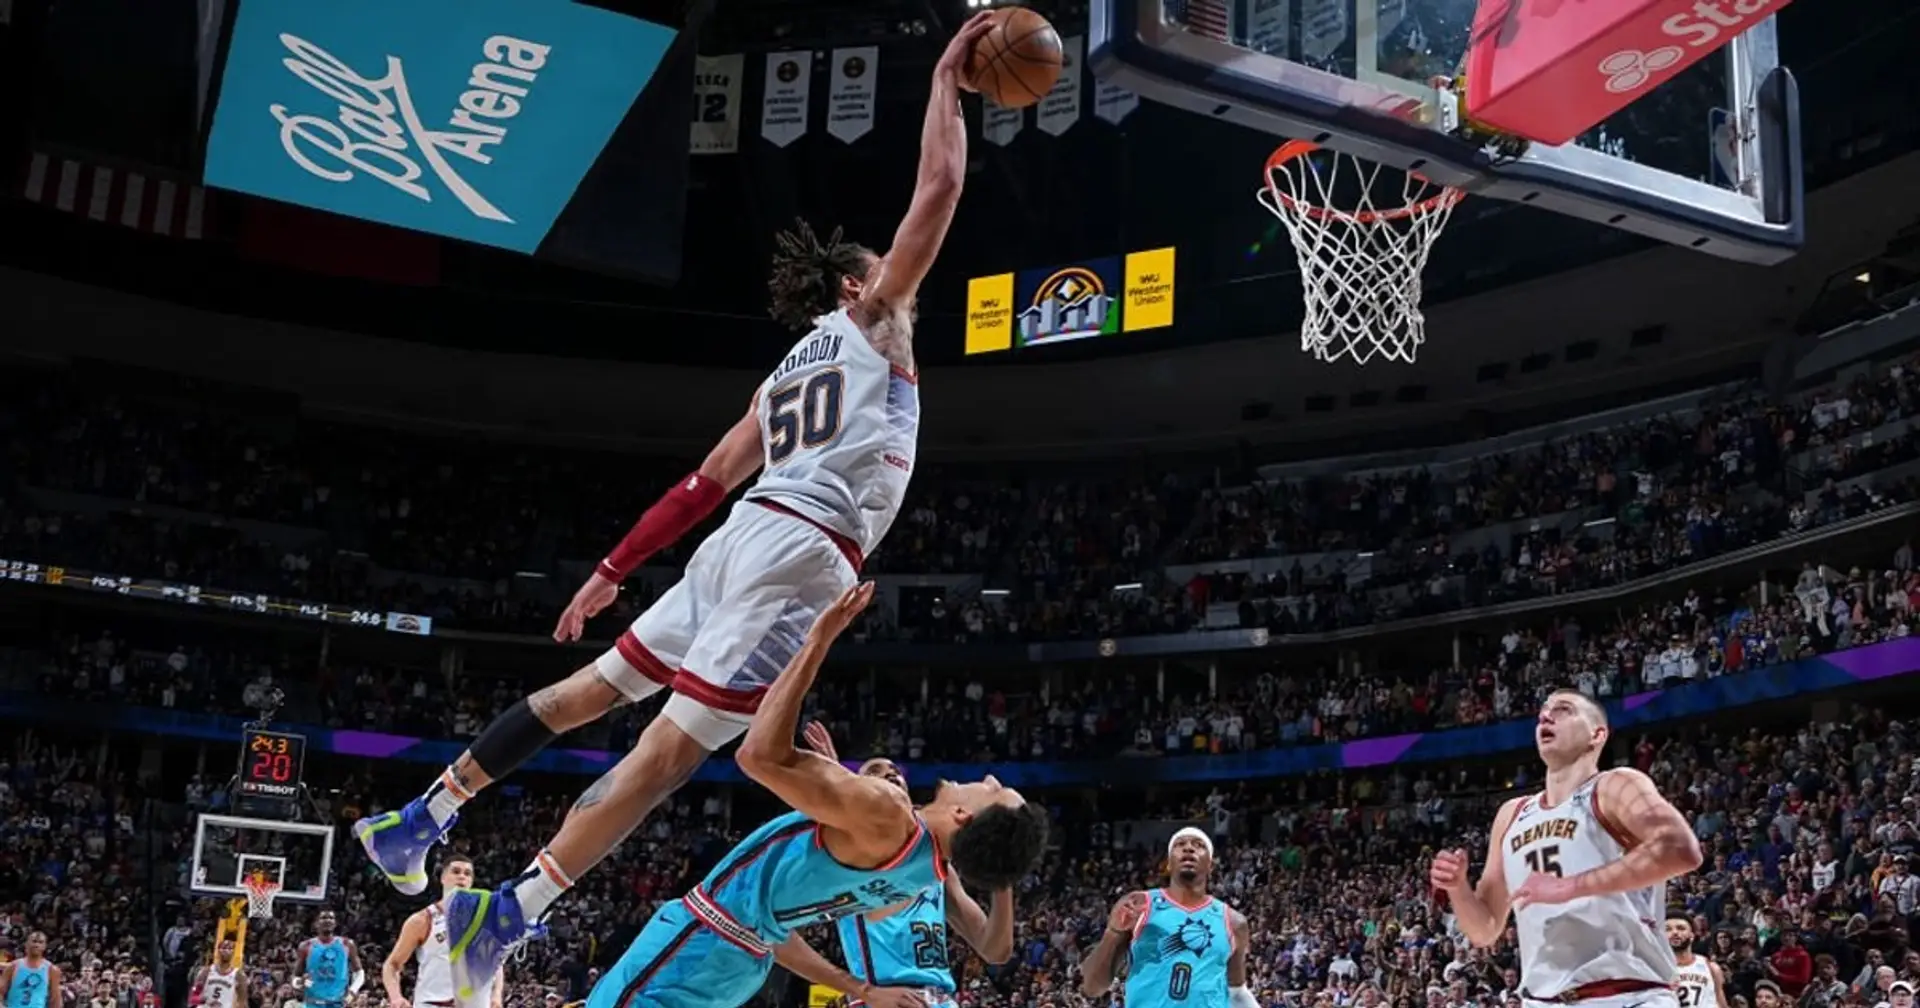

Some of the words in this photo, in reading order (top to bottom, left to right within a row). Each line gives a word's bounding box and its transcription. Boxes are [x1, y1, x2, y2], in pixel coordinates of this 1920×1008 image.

[425, 35, 552, 165] Arena
[270, 32, 470, 215] Ball
[1128, 284, 1170, 297] Western
[1134, 295, 1166, 306] Union
[970, 308, 1010, 321] Western
[975, 319, 1004, 330] Union
[768, 366, 843, 465] 50
[350, 610, 380, 625] 24.6
[252, 735, 288, 754] 24.3
[252, 752, 291, 781] 20
[257, 783, 296, 795] TISSOT
[1511, 818, 1578, 854] DENVER
[1524, 844, 1563, 879] 15
[1168, 941, 1192, 1001] 0
[212, 986, 222, 999] 5
[1677, 985, 1702, 1007] 27
